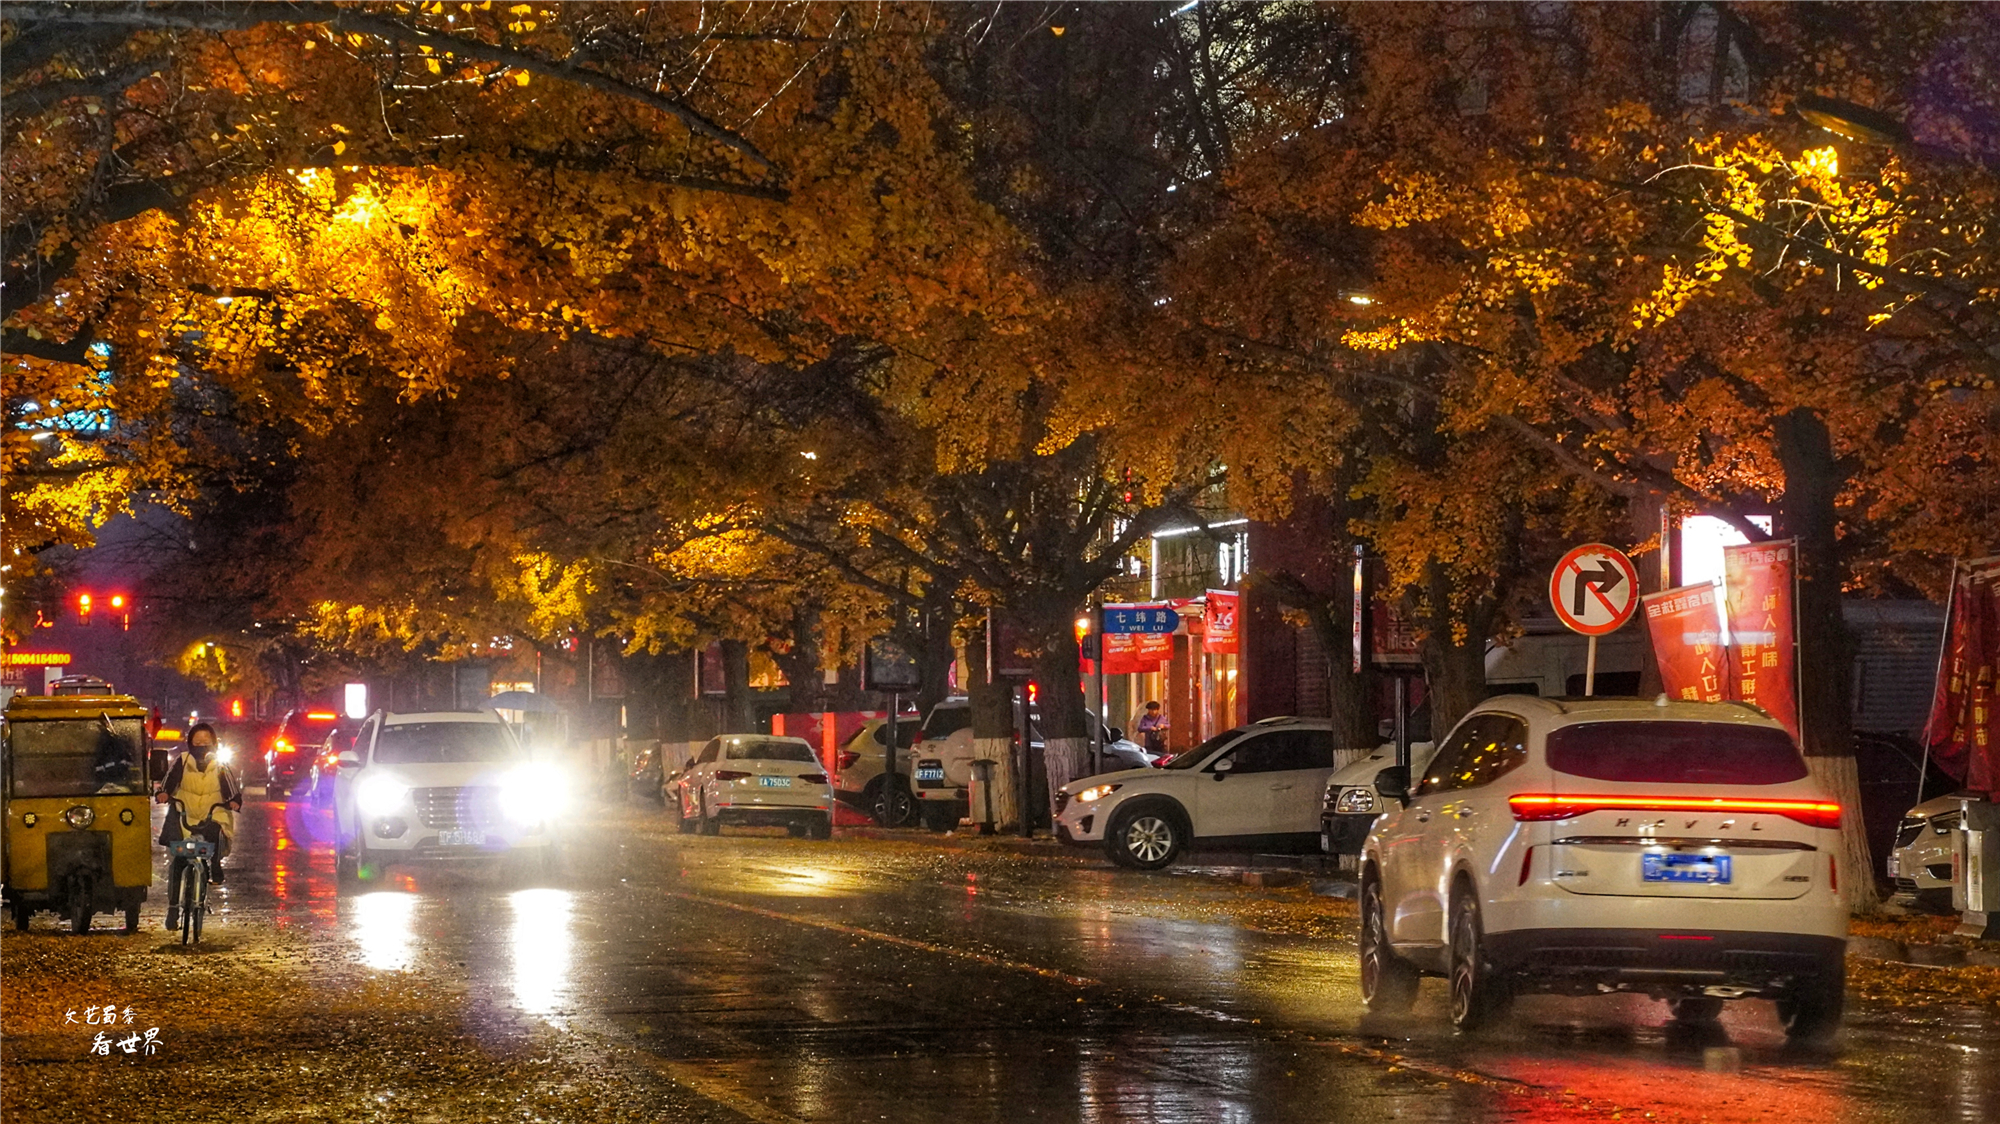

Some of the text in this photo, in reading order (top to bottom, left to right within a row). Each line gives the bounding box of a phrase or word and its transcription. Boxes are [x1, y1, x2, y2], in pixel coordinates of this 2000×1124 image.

[1115, 611, 1167, 624] 七纬路
[1214, 612, 1234, 625] 16
